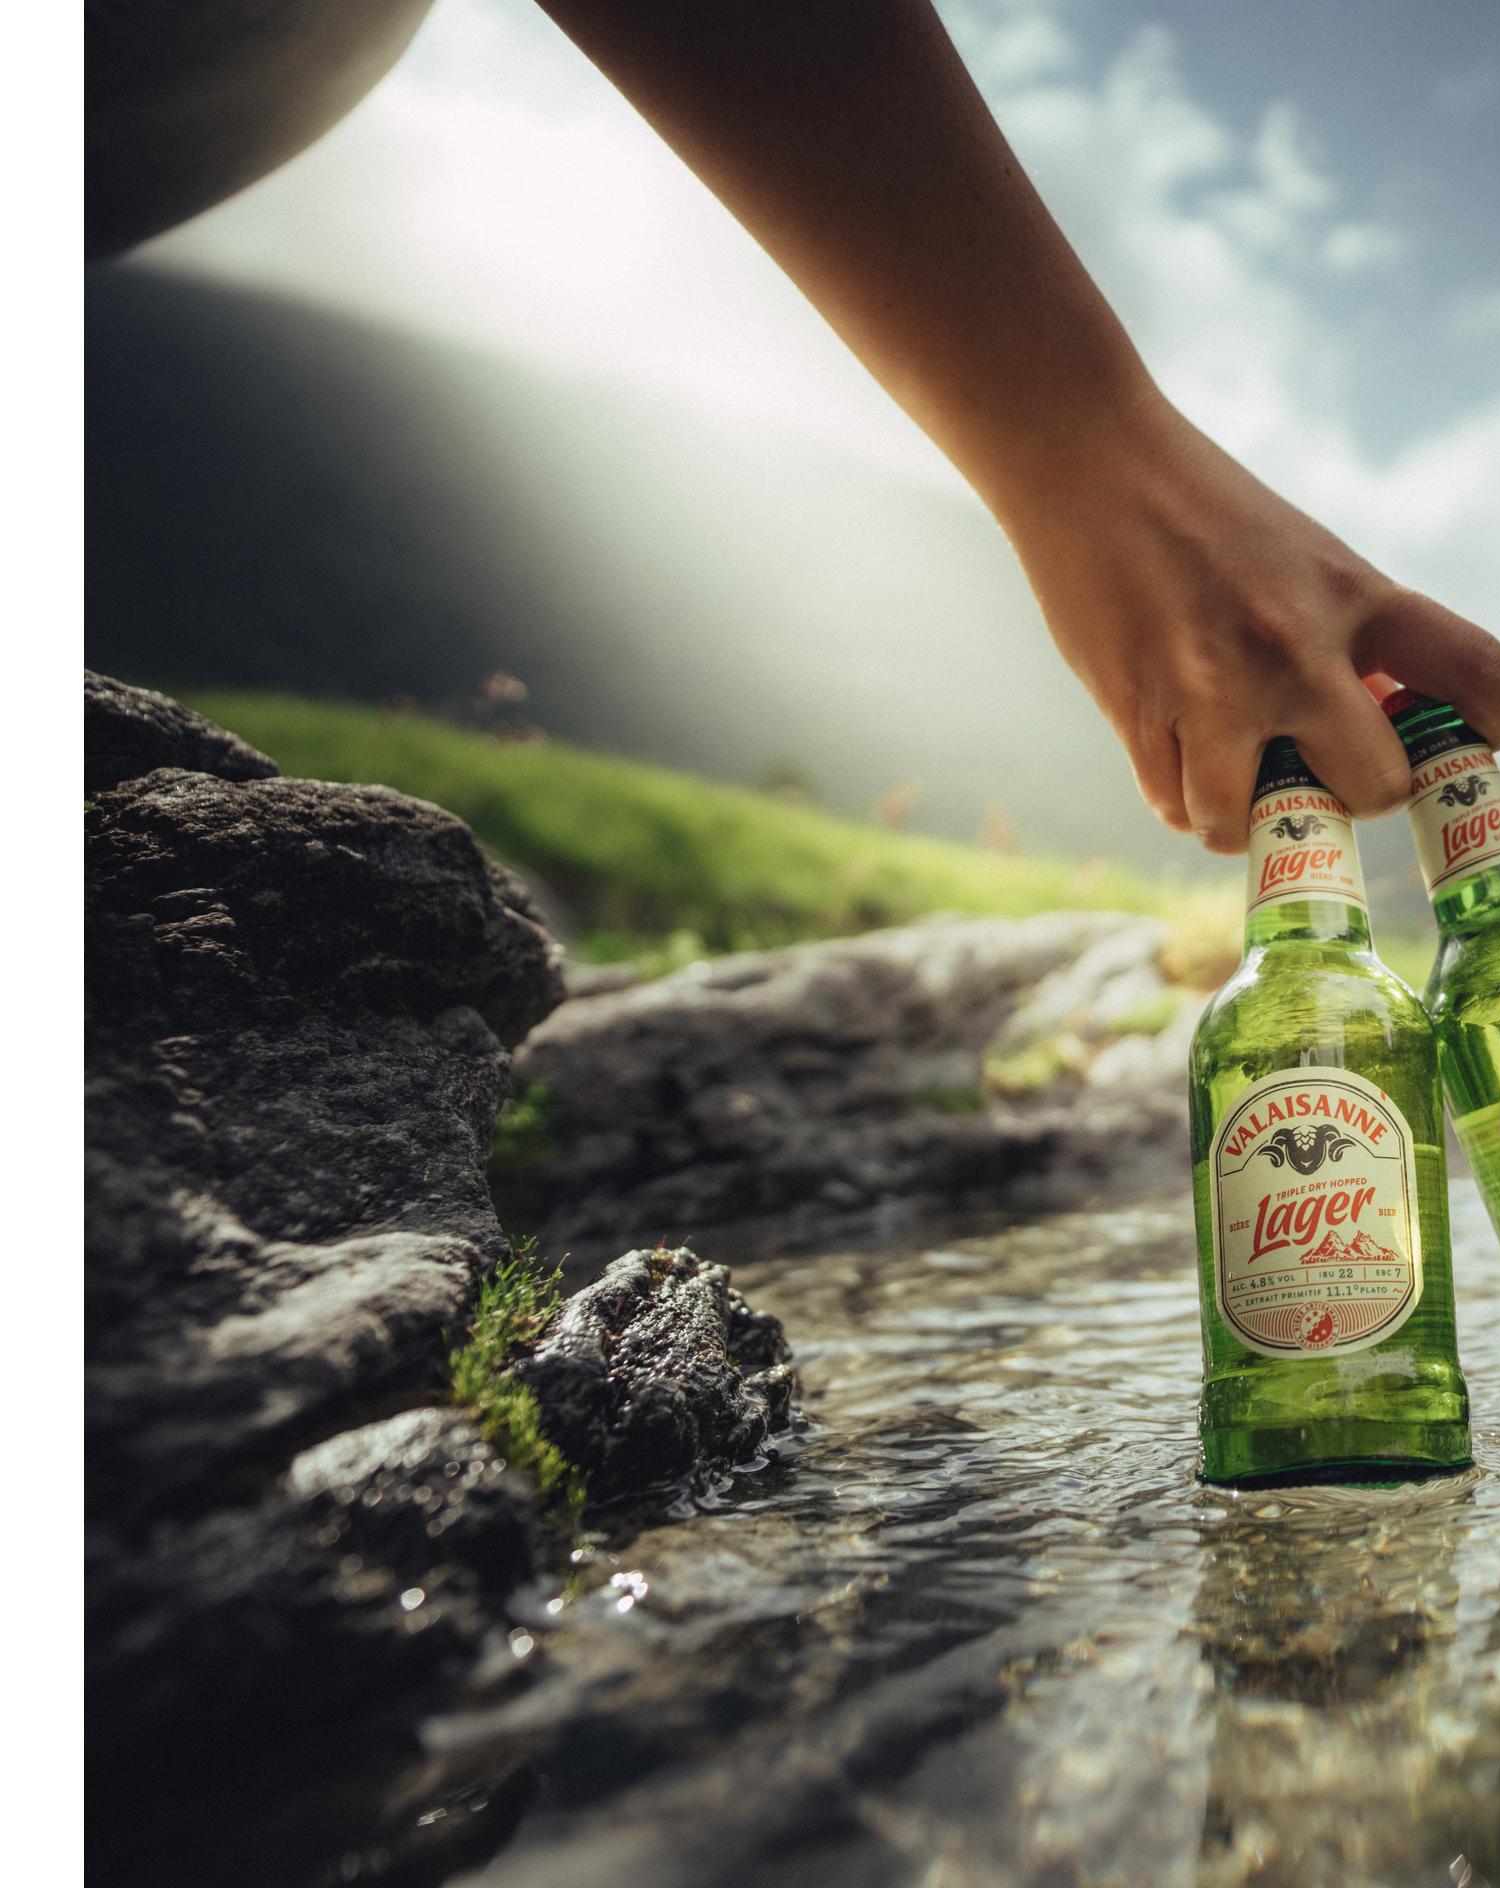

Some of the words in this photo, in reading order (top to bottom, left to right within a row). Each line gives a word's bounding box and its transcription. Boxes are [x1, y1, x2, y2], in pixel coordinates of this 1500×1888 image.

[1257, 848, 1343, 897] Lager
[1225, 1093, 1388, 1157] VALAISANNE
[1276, 1185, 1306, 1201] TRIPLE
[1308, 1181, 1328, 1193] DRY
[1330, 1177, 1367, 1189] HOPPED
[1378, 1208, 1397, 1217] BIER
[1229, 1219, 1250, 1232] BIÈRE
[1248, 1186, 1376, 1264] Lager
[1338, 1268, 1353, 1278] 22
[1394, 1268, 1401, 1278] 7
[1232, 1283, 1247, 1292] ALC.
[1250, 1275, 1275, 1289] 4.8%
[1277, 1274, 1295, 1282] VOL
[1245, 1294, 1278, 1306] EXTRAIT
[1281, 1288, 1322, 1299] PRIMITIF
